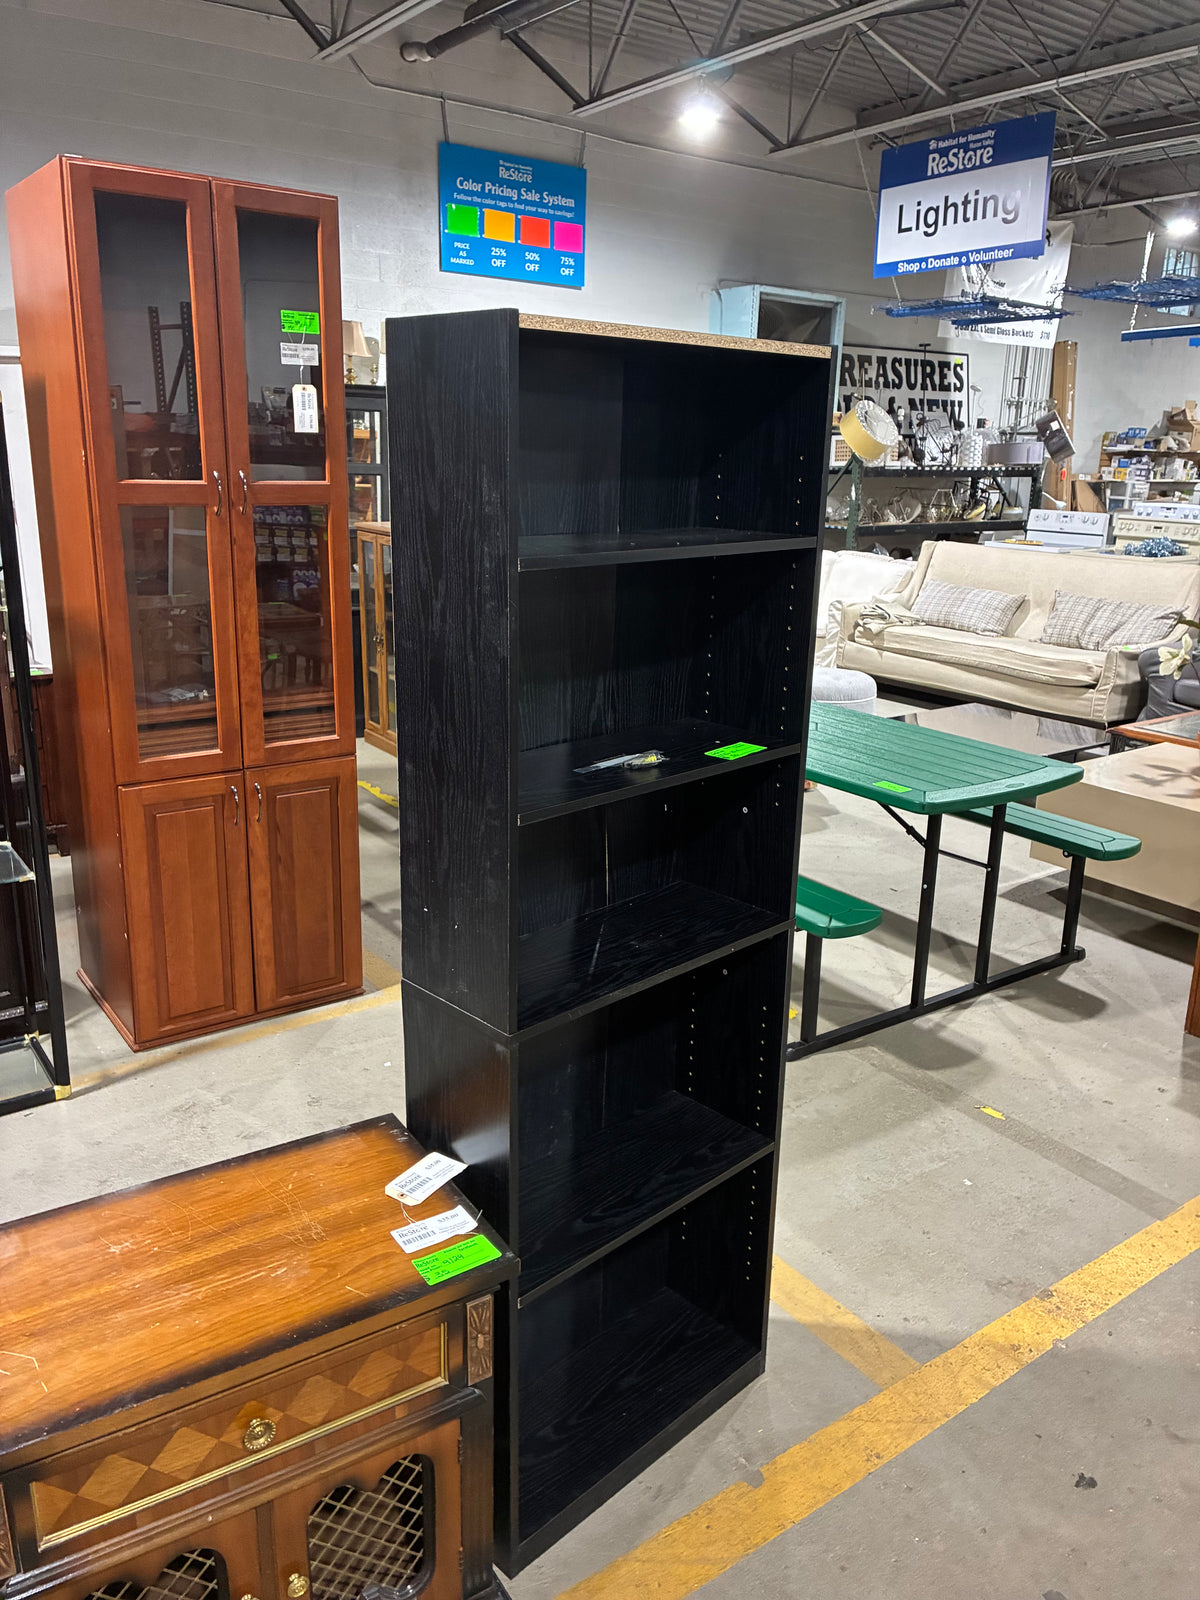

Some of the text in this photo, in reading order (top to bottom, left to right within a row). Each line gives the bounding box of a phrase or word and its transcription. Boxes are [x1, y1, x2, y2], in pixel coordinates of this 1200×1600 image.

[938, 137, 958, 148] Habitat
[968, 130, 996, 141] Humanity
[927, 147, 994, 176] ReStore
[499, 167, 532, 183] ReStore
[457, 177, 575, 207] Color Pricing Sale System
[454, 193, 472, 202] Follow
[473, 195, 481, 203] the
[482, 197, 496, 205] color
[496, 200, 507, 208] tags
[514, 202, 524, 210] find
[554, 209, 575, 218] savings!
[897, 189, 1022, 238] Lighting
[454, 242, 470, 250] PRICE
[491, 248, 507, 257] 25%
[450, 257, 474, 266] MARKED
[525, 252, 540, 261] 50%
[560, 257, 575, 266] 75%
[897, 248, 1014, 273] Shop Donate Volunteer
[491, 259, 506, 268] OFF
[525, 263, 540, 272] OFF
[560, 268, 575, 276] OFF
[984, 325, 996, 335] Semi
[996, 327, 1011, 336] Gloss
[1011, 328, 1034, 338] Buckets
[840, 353, 965, 393] REASURES
[399, 1174, 422, 1190] ReStore
[399, 1225, 429, 1239] ReStore
[415, 1256, 439, 1268] ReStore
